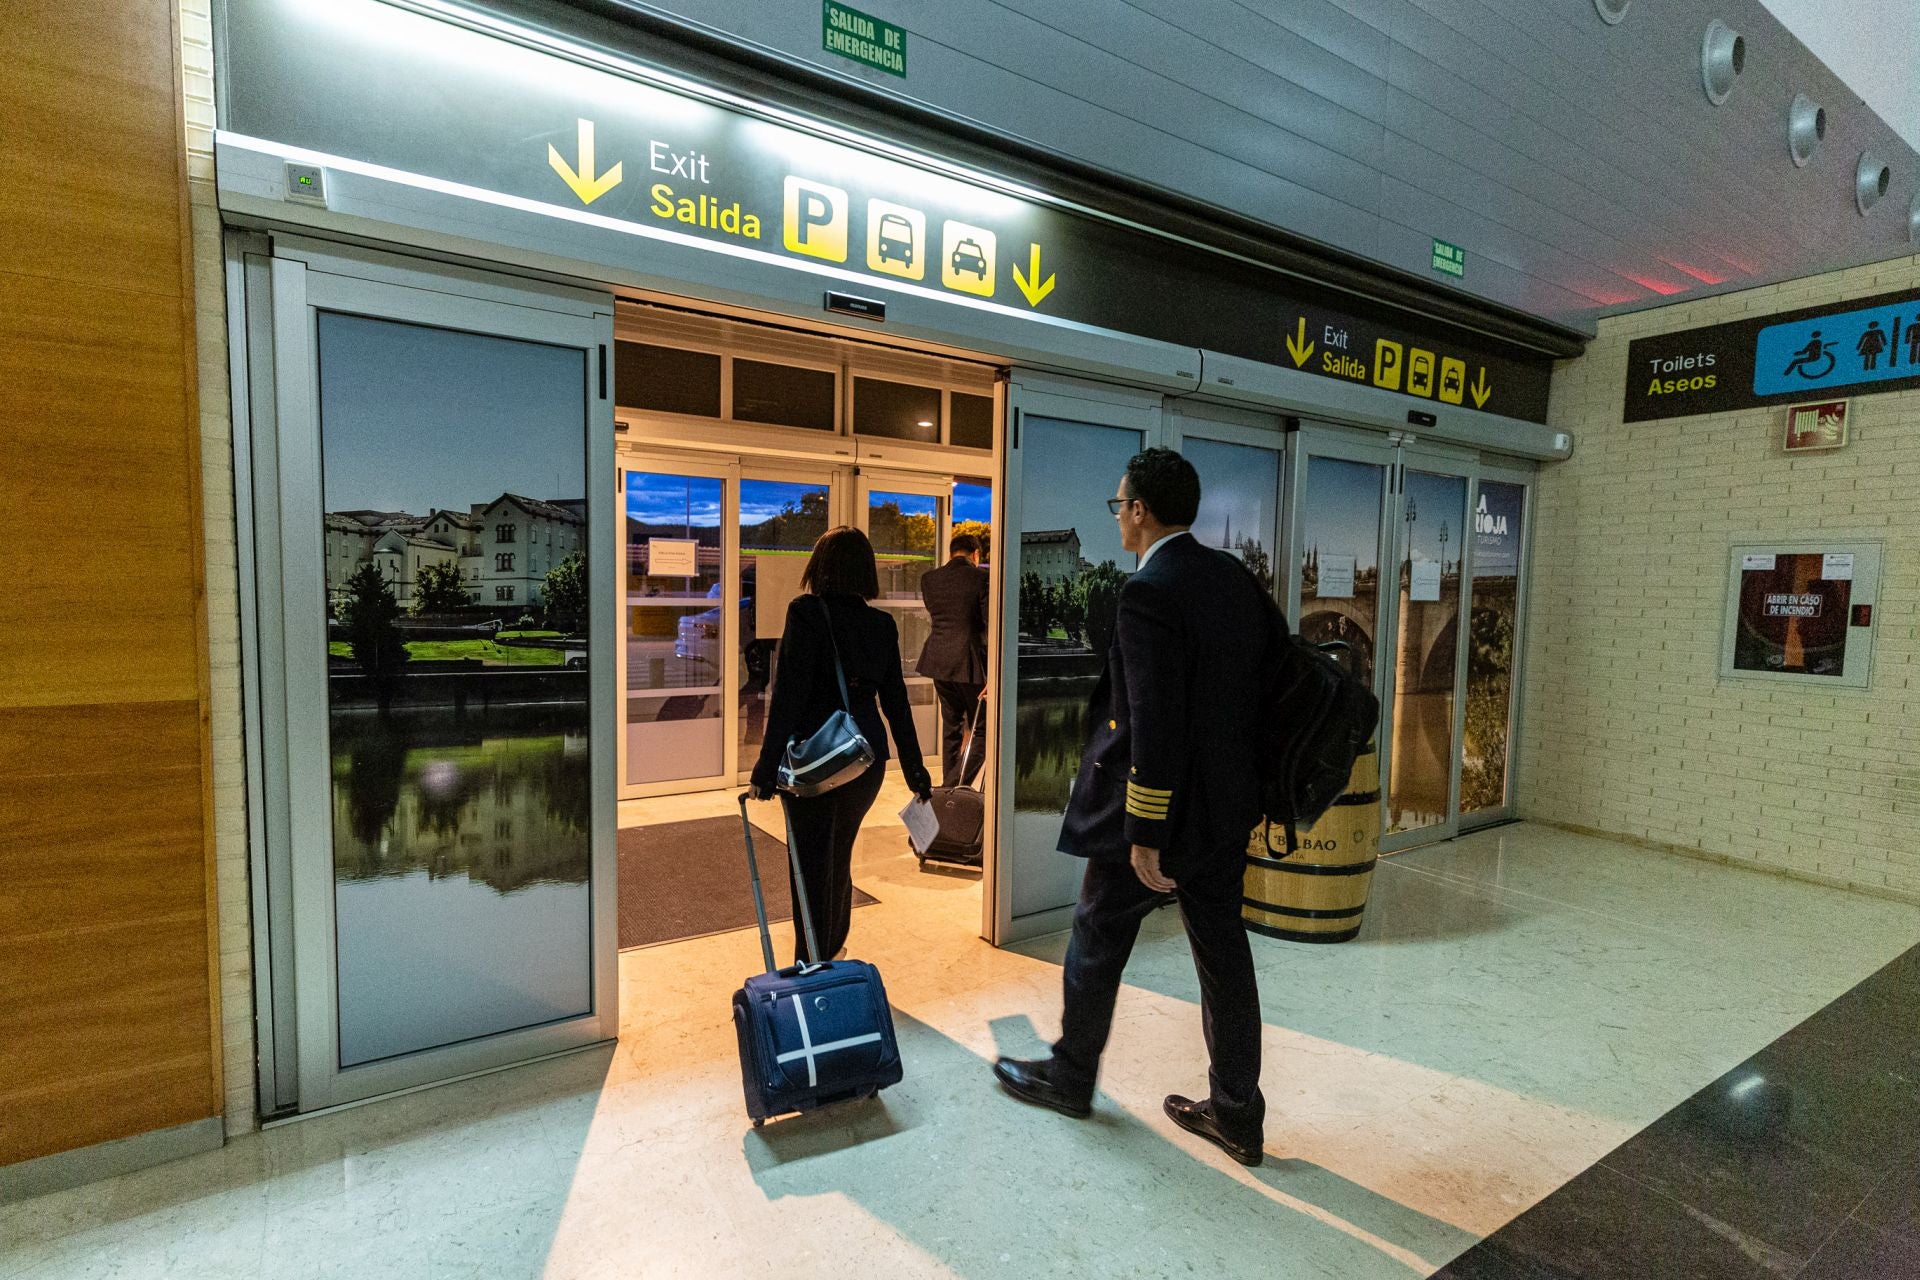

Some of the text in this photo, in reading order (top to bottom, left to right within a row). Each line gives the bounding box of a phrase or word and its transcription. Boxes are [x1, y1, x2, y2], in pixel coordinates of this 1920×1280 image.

[830, 7, 901, 50] SALIDA DE
[826, 28, 904, 72] EMERGENCIA
[649, 139, 710, 184] Exit
[650, 184, 761, 240] Salida
[1324, 325, 1348, 349] Exit
[1322, 351, 1366, 380] Salida
[1650, 352, 1717, 374] Toilets
[1647, 374, 1718, 396] Aseos
[1767, 595, 1820, 606] ABRIR EN CASO
[1769, 605, 1815, 616] DE INCENDIO
